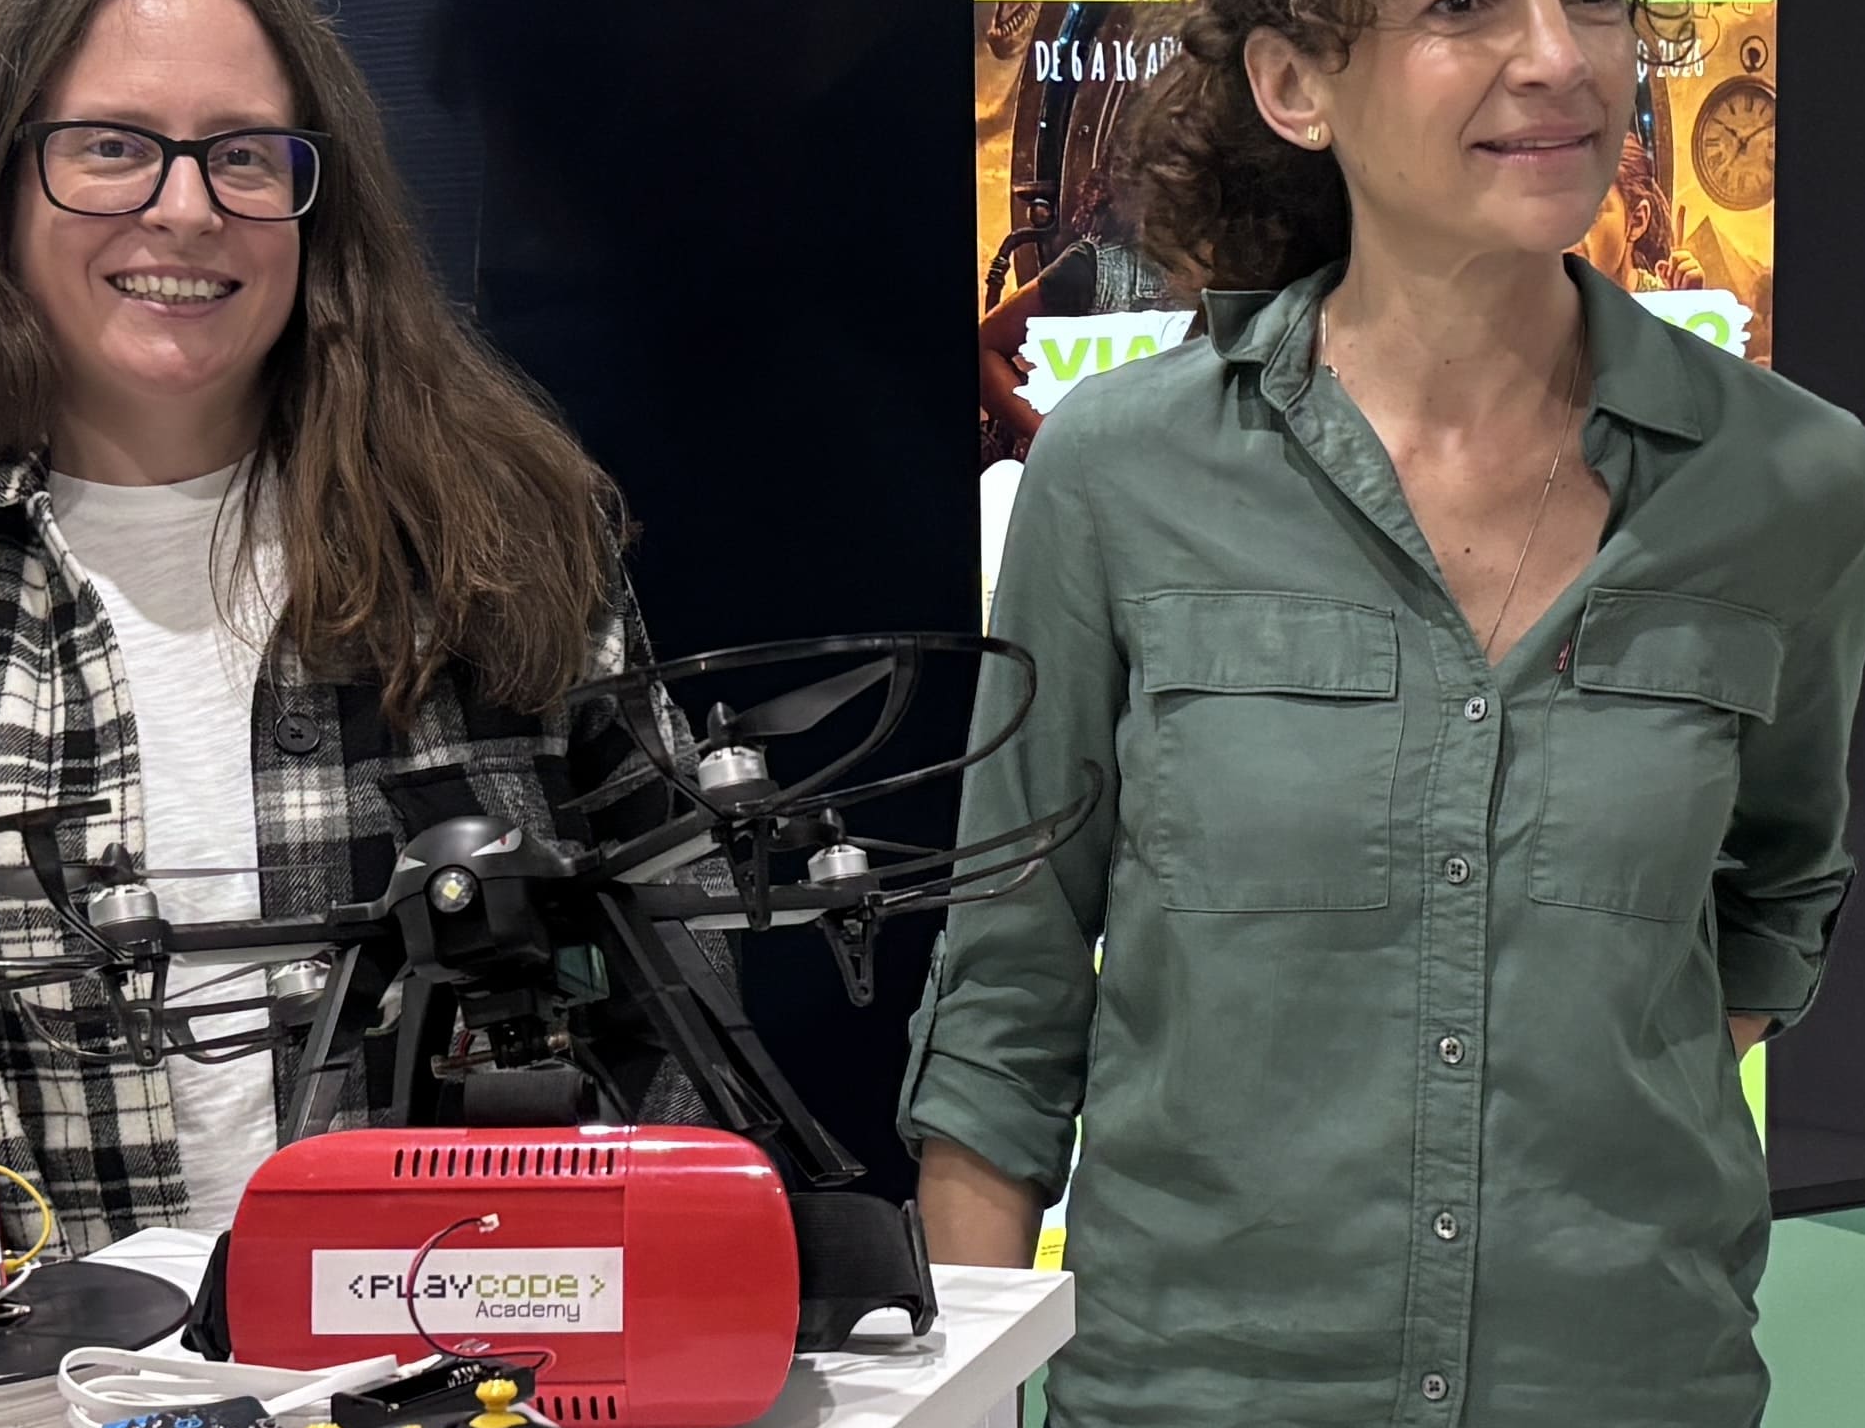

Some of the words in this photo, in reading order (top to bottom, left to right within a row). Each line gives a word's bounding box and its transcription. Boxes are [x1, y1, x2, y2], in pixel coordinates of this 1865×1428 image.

[1035, 39, 1064, 82] DE
[1071, 39, 1083, 82] 6
[1091, 39, 1105, 82] A
[1112, 39, 1137, 82] 16
[475, 1300, 581, 1323] Academy
